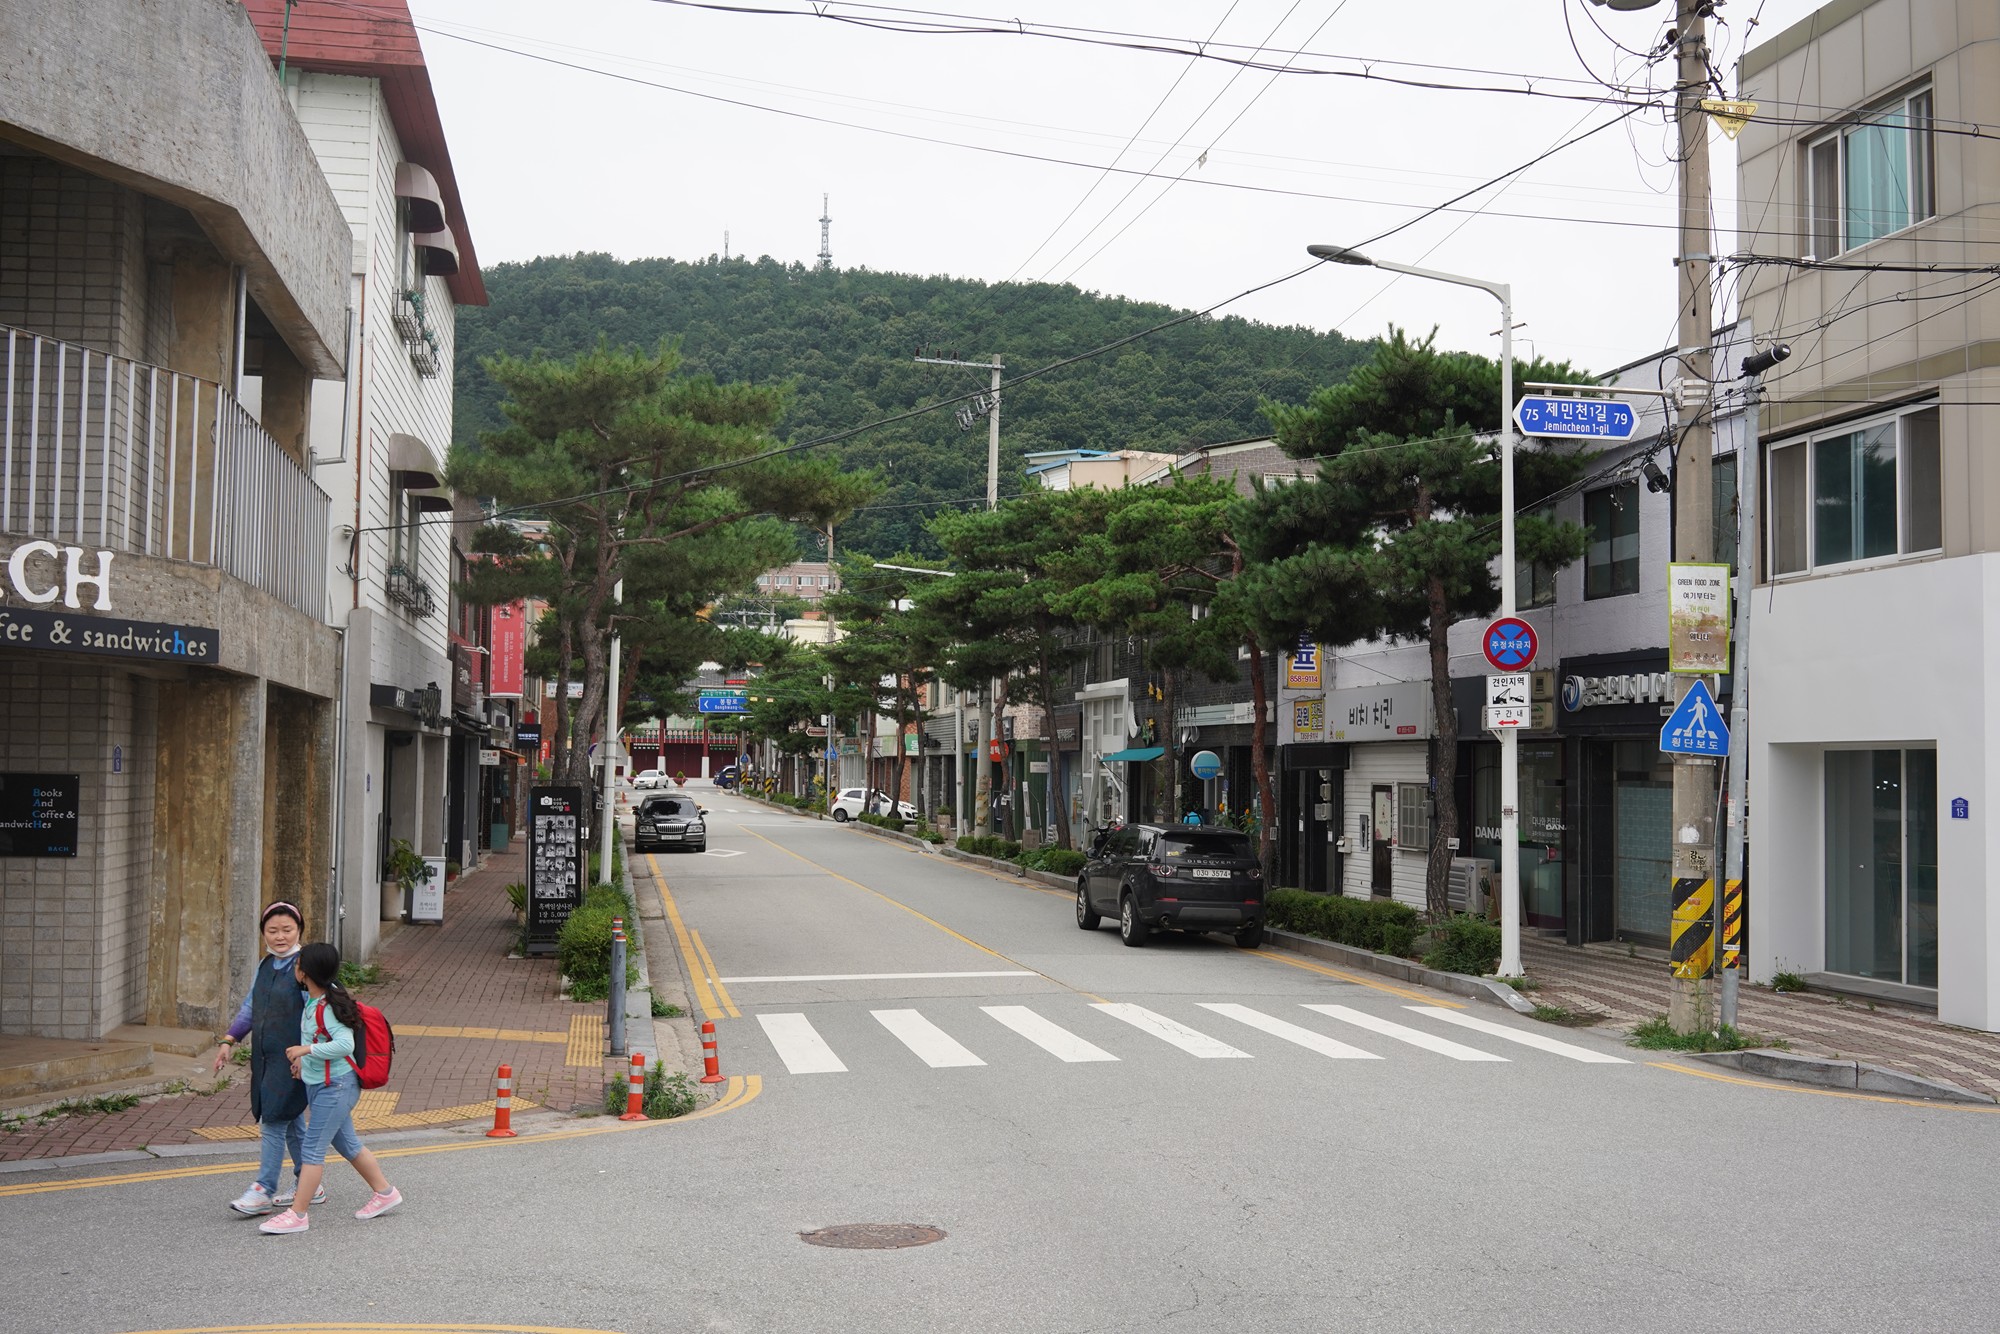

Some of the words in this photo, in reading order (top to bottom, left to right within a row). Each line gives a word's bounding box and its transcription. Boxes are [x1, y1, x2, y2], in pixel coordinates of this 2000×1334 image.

[1525, 409, 1539, 421] 75
[1545, 402, 1607, 422] 제민천1길
[1614, 413, 1628, 425] 79
[1544, 421, 1590, 433] Jemincheon
[1592, 423, 1610, 436] 1-gil
[0, 540, 115, 611] CH
[1677, 578, 1693, 586] GREEN
[1694, 578, 1707, 586] FOOD
[1709, 579, 1720, 587] ZONE
[1683, 592, 1716, 600] 여기부터는
[50, 619, 72, 645] &
[82, 626, 207, 657] sandwiches
[1491, 640, 1531, 650] 주정차금지
[1290, 675, 1318, 683] 858-9114
[1493, 676, 1525, 687] 견인지역
[1372, 698, 1393, 729] 치킨
[1671, 737, 1718, 749] 횡단보도
[32, 788, 62, 797] Books
[33, 799, 53, 807] And
[32, 810, 64, 819] Coffee
[66, 811, 75, 819] &
[1956, 807, 1964, 817] 15
[1474, 826, 1502, 840] DANA
